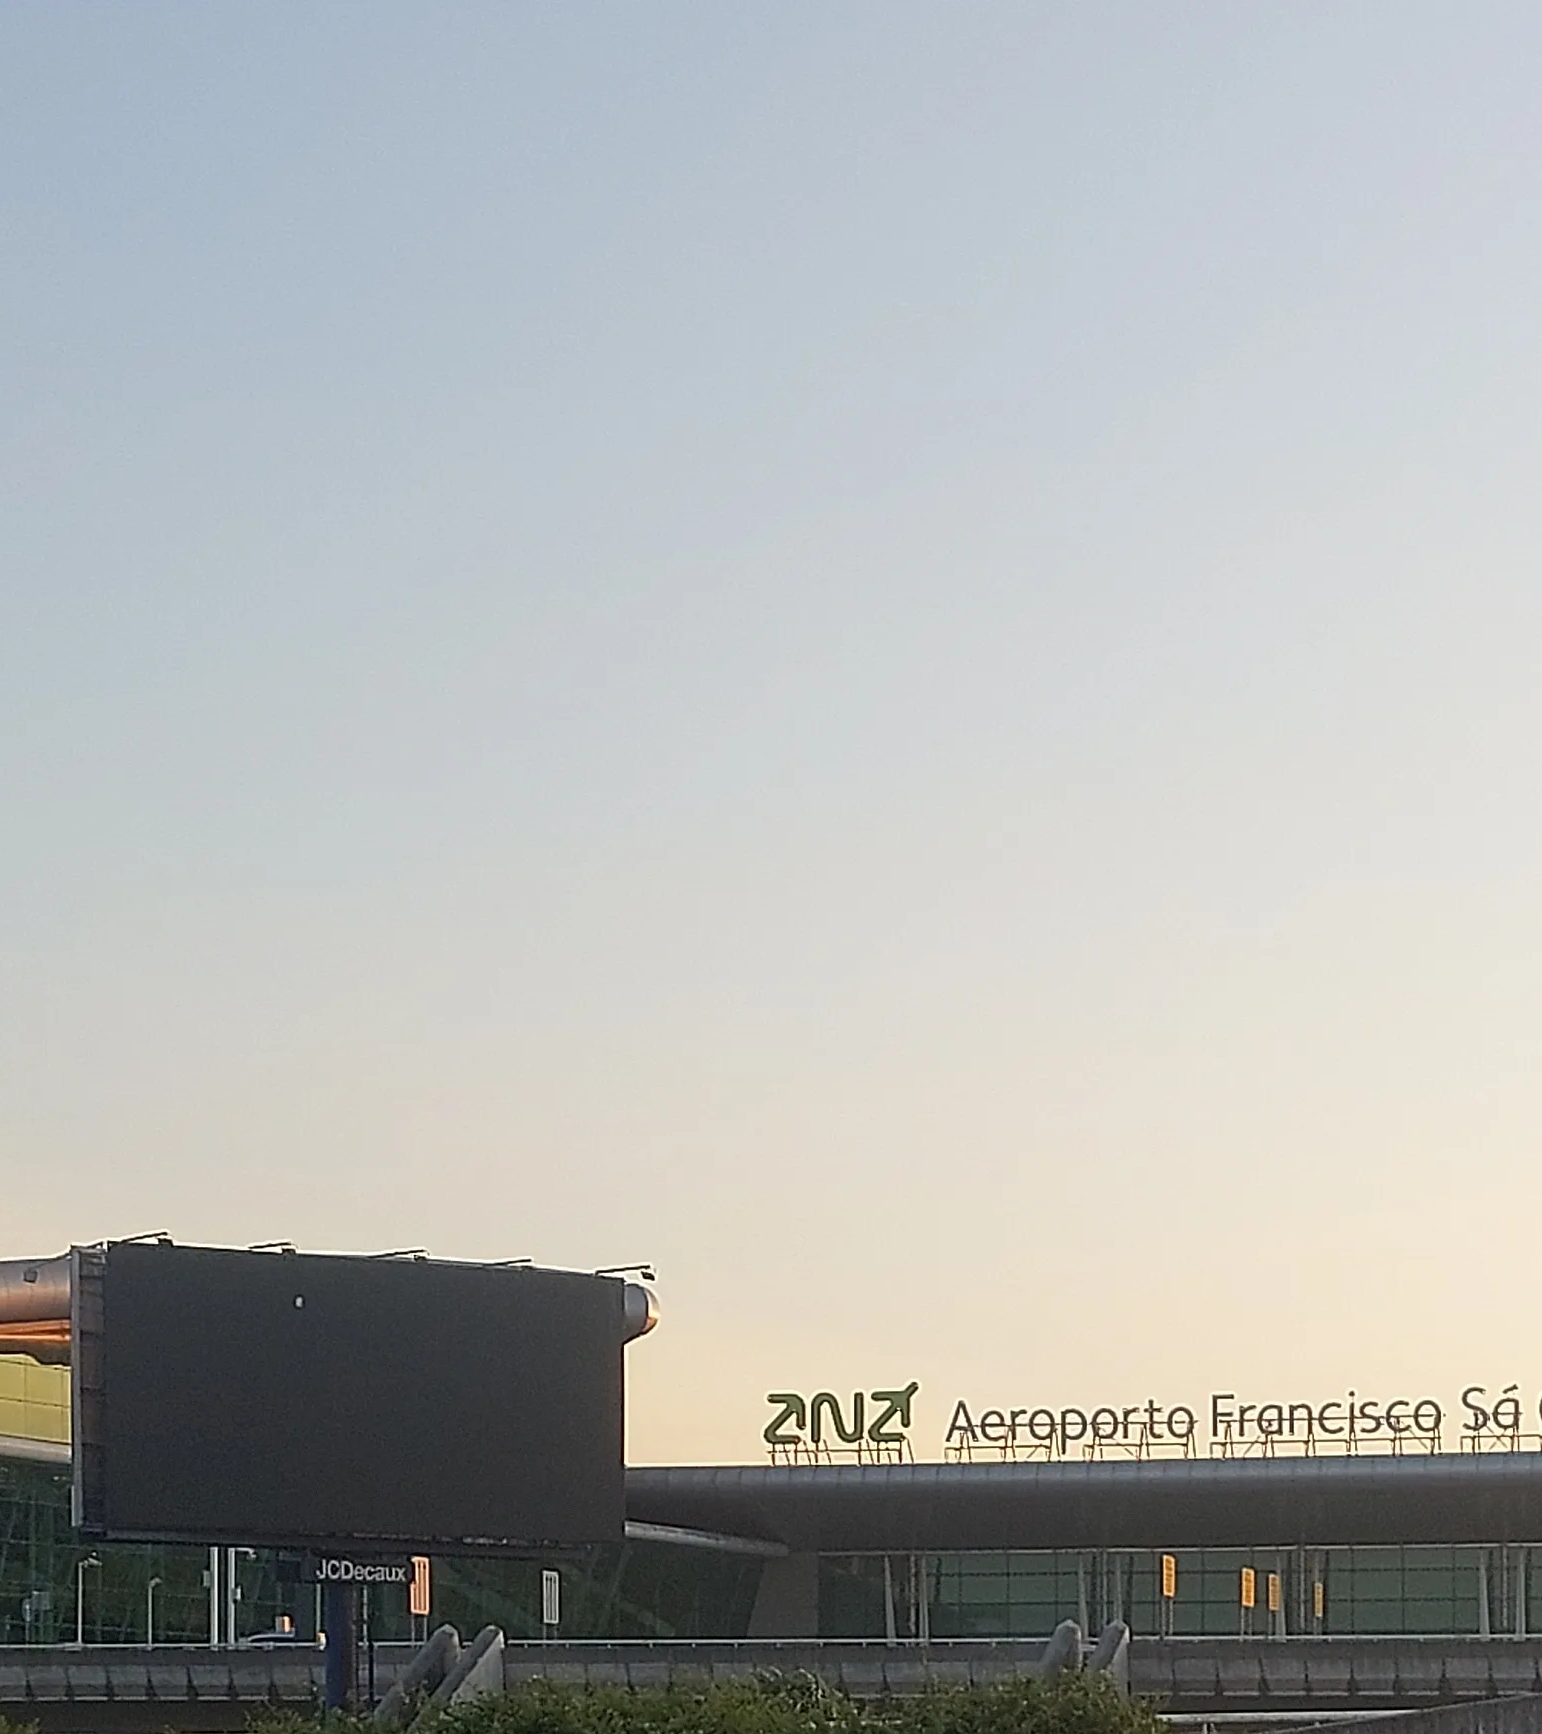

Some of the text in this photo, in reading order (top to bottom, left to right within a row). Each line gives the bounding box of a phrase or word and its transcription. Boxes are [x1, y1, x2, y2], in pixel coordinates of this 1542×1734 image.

[945, 1397, 1196, 1455] Aeroporto
[1211, 1390, 1443, 1437] Francisco
[1461, 1383, 1520, 1432] Sá
[316, 1558, 407, 1582] JCDecaux
